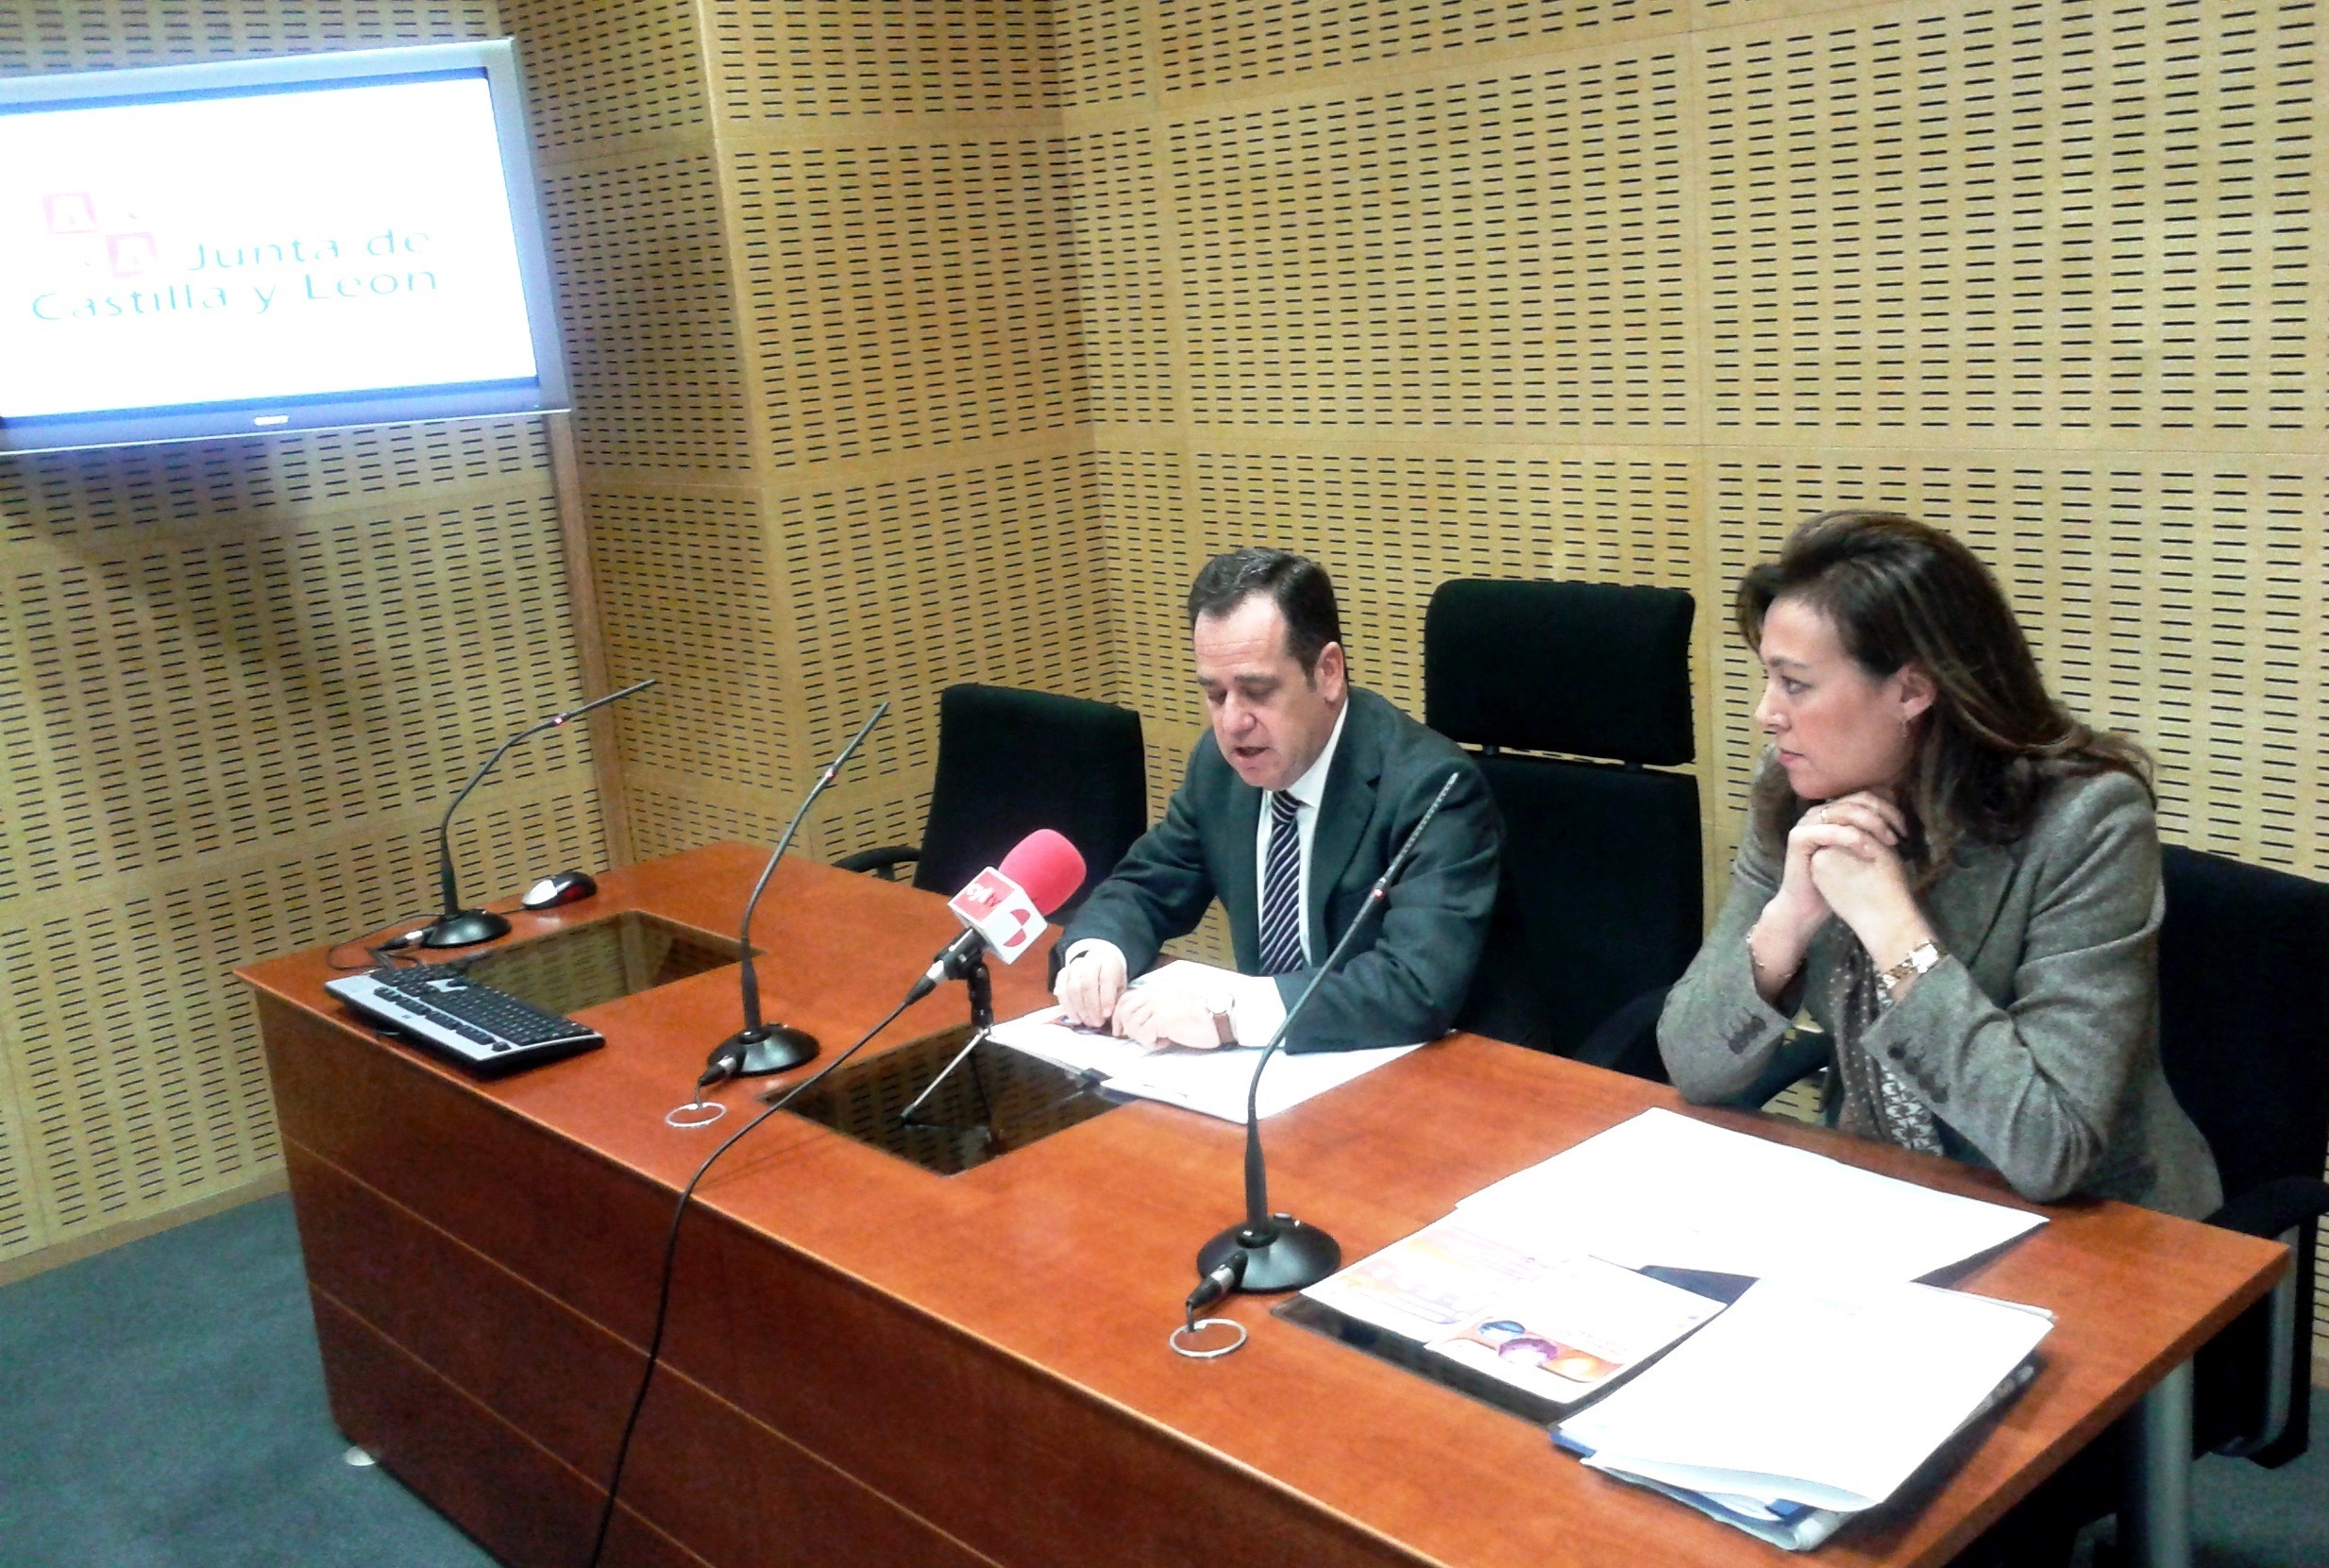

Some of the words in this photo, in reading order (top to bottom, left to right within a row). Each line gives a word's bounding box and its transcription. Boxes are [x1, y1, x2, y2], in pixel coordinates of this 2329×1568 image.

[186, 238, 339, 271] Junta
[365, 228, 430, 257] de
[32, 283, 228, 320] Castilla
[253, 284, 276, 314] y
